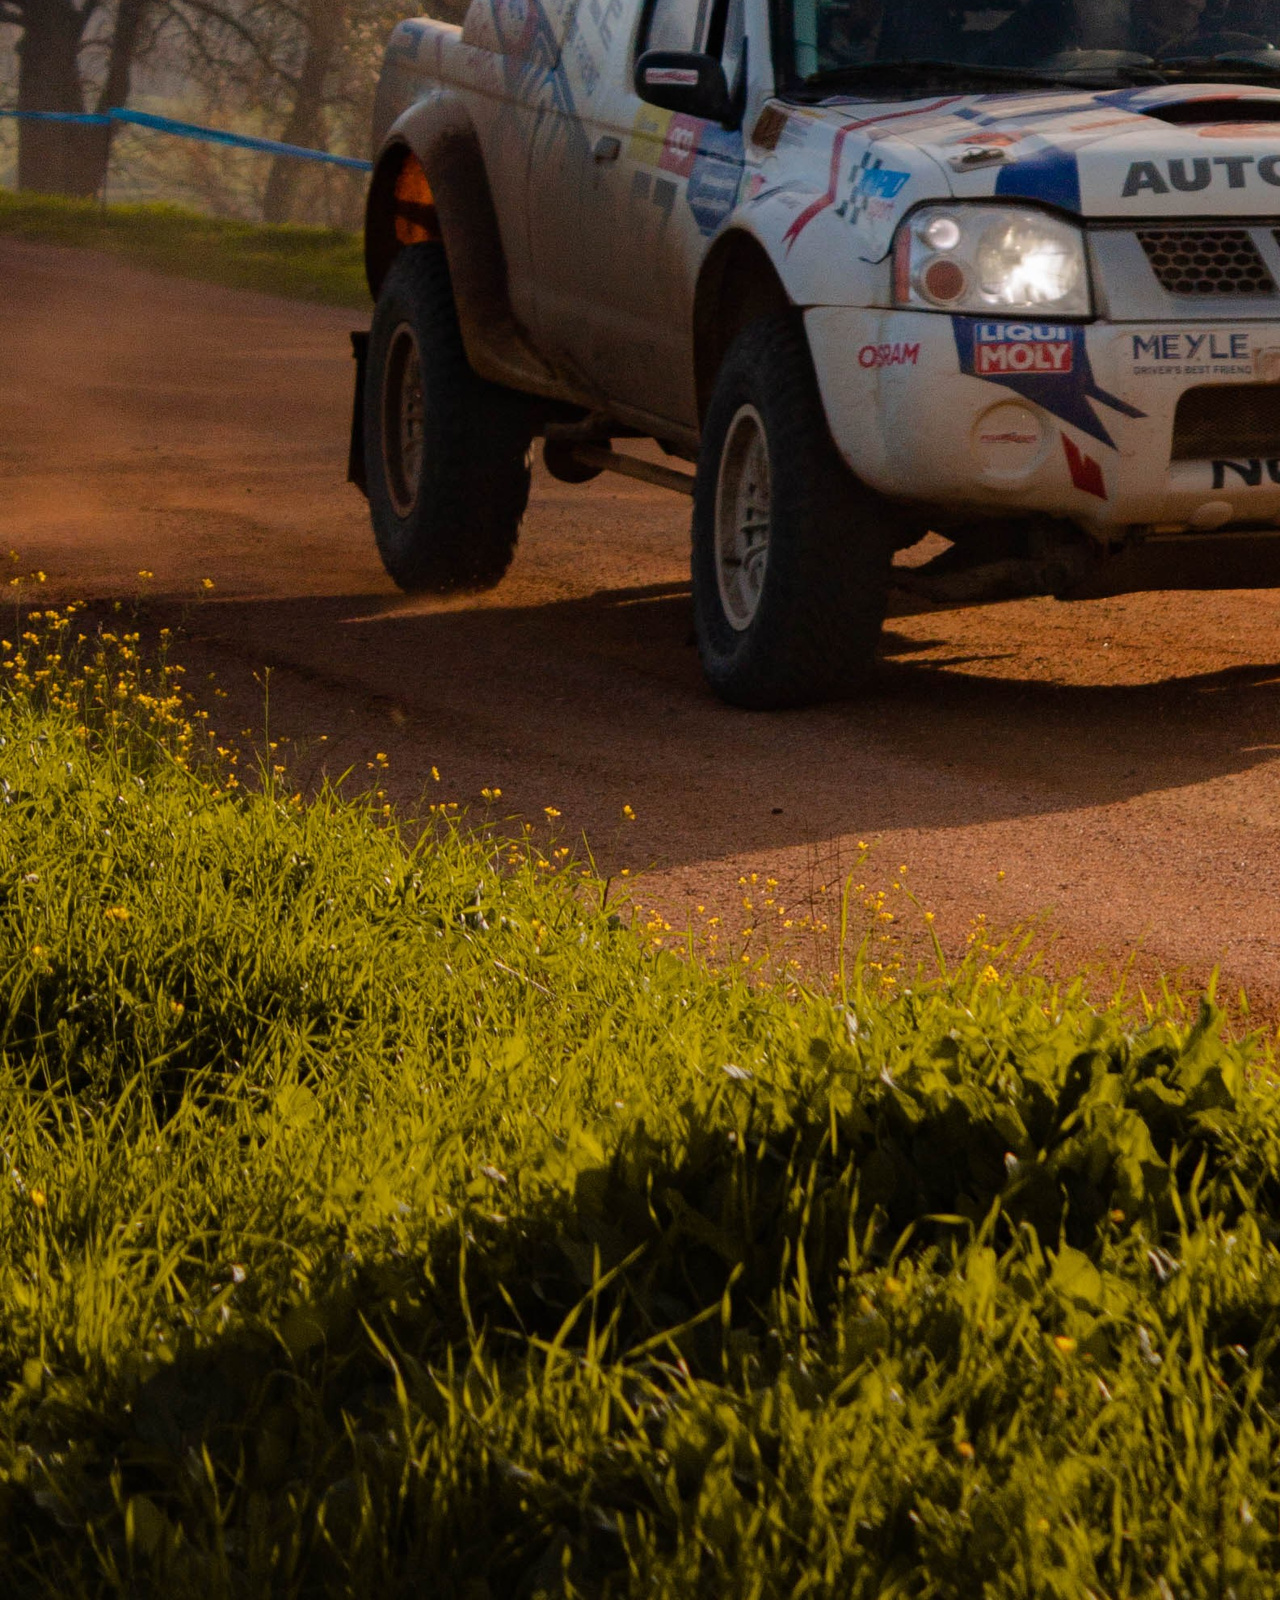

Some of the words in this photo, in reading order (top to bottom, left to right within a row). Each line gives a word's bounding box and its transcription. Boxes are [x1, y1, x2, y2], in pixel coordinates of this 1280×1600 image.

[980, 324, 1067, 342] LIQUI
[1132, 333, 1251, 360] MEYLE
[858, 342, 922, 369] OSRAM
[980, 343, 1069, 371] MOLY
[1184, 365, 1210, 375] BEST
[1213, 365, 1252, 375] FRIEND
